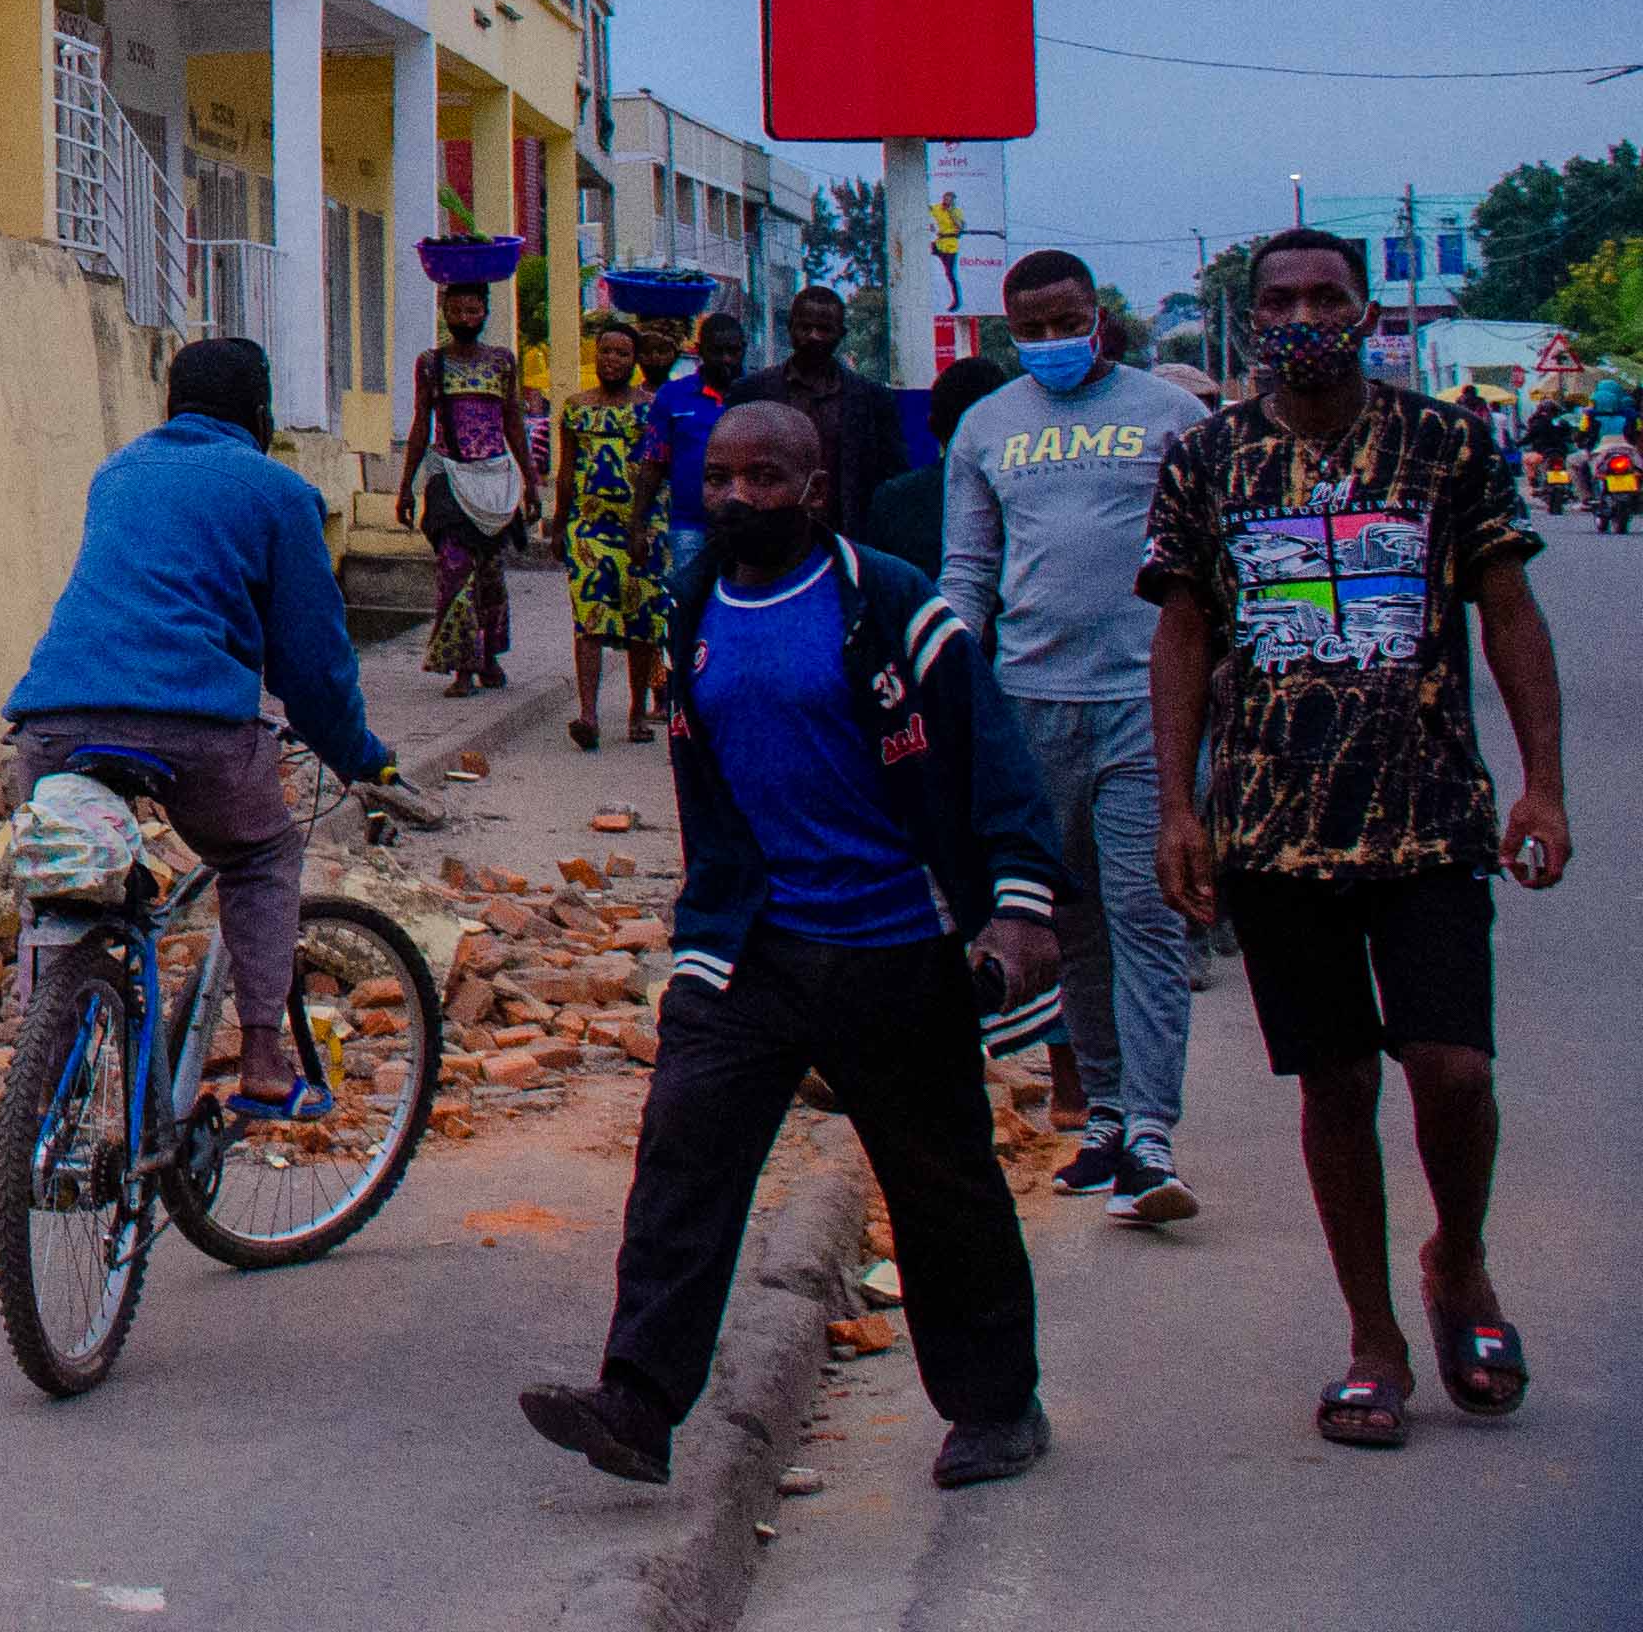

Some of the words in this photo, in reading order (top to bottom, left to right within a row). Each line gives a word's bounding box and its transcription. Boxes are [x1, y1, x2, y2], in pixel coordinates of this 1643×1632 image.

[998, 423, 1148, 473] RAMS
[1219, 503, 1339, 526] SHOREWOOD
[1352, 498, 1435, 513] KIWANIS
